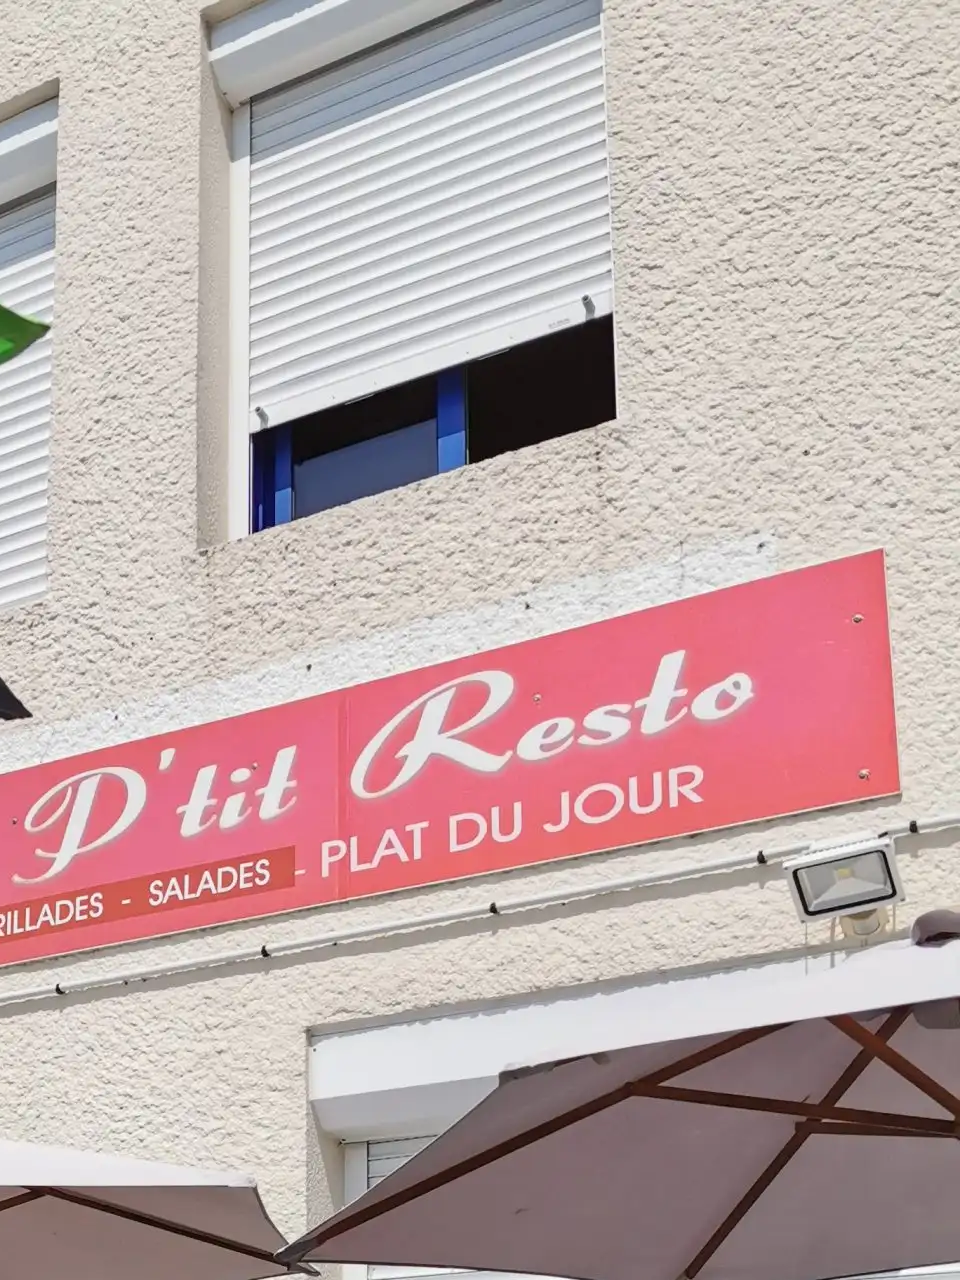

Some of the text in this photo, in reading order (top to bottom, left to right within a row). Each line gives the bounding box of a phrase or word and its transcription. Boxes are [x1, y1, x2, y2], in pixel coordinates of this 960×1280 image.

[349, 649, 754, 799] Resto
[148, 858, 271, 907] SALADES
[321, 821, 429, 878] PLAT
[449, 800, 523, 853] DU
[543, 764, 705, 834] JOUR
